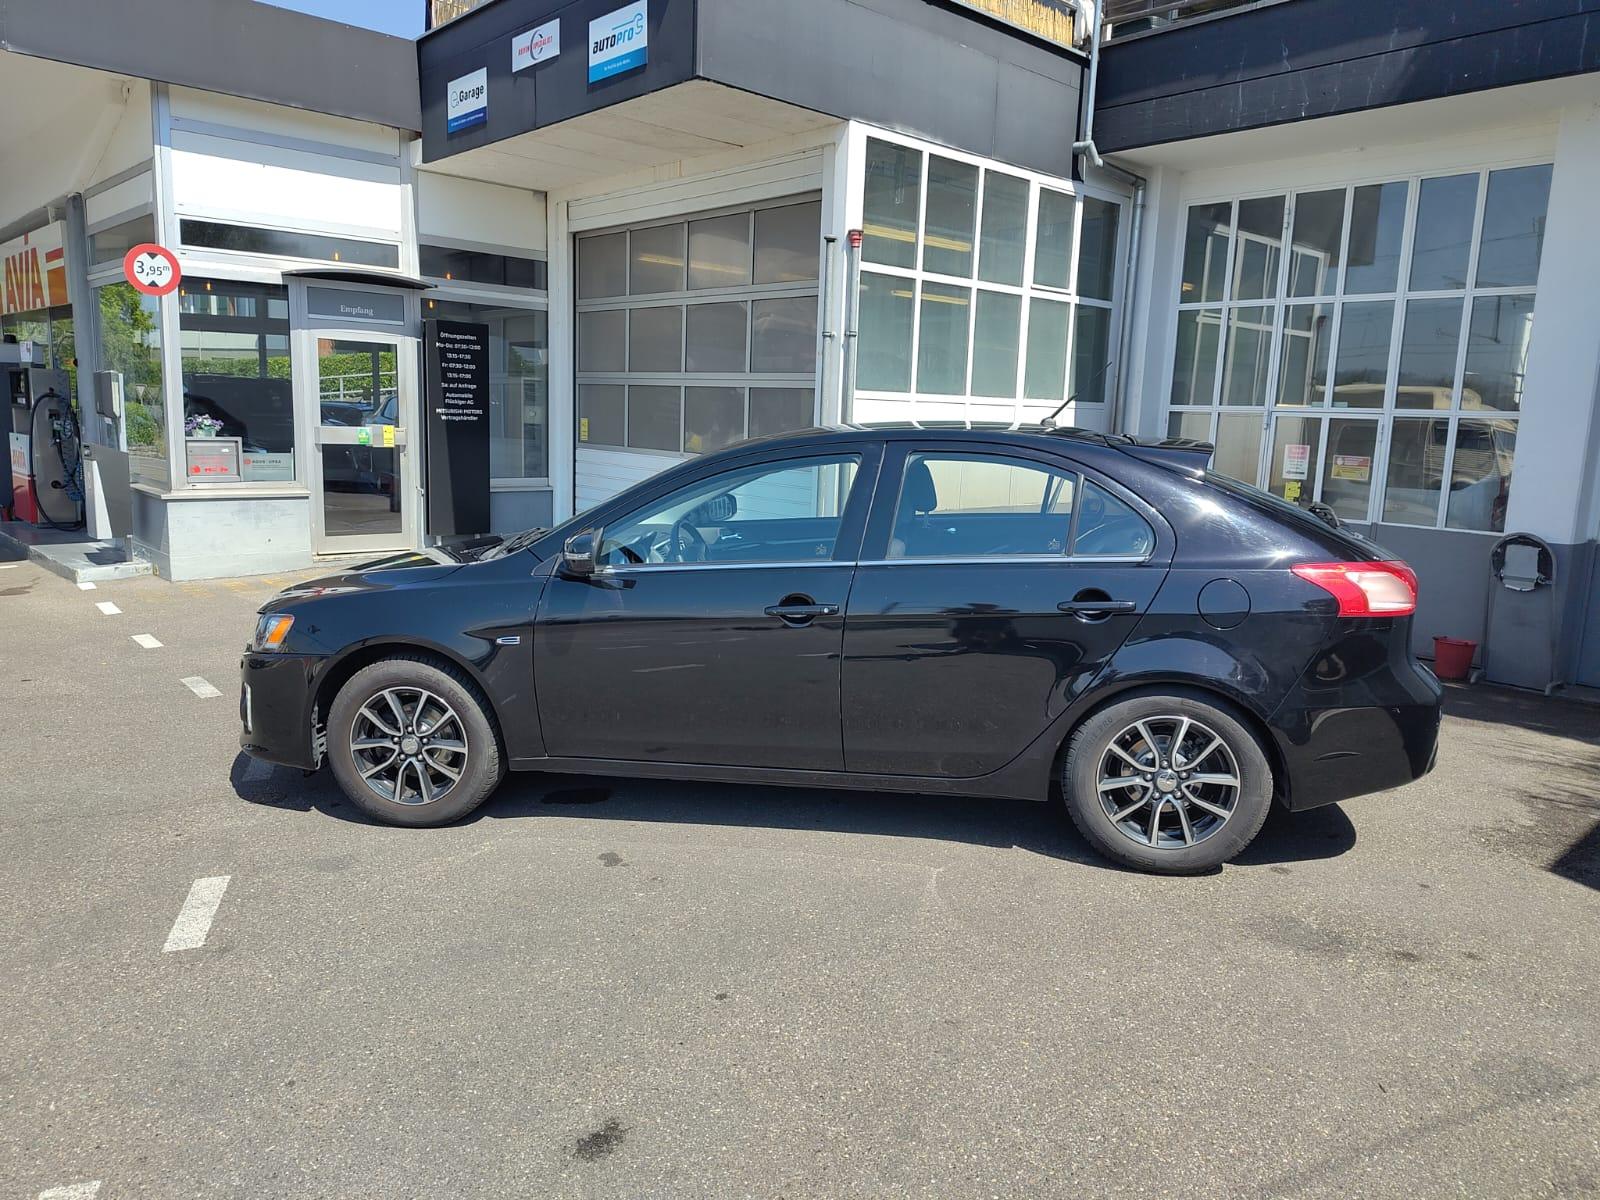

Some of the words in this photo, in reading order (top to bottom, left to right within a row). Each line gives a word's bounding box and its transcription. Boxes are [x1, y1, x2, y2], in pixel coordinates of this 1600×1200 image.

[459, 85, 484, 102] Garage
[5, 245, 46, 313] AVIA
[340, 304, 374, 316] Empfang
